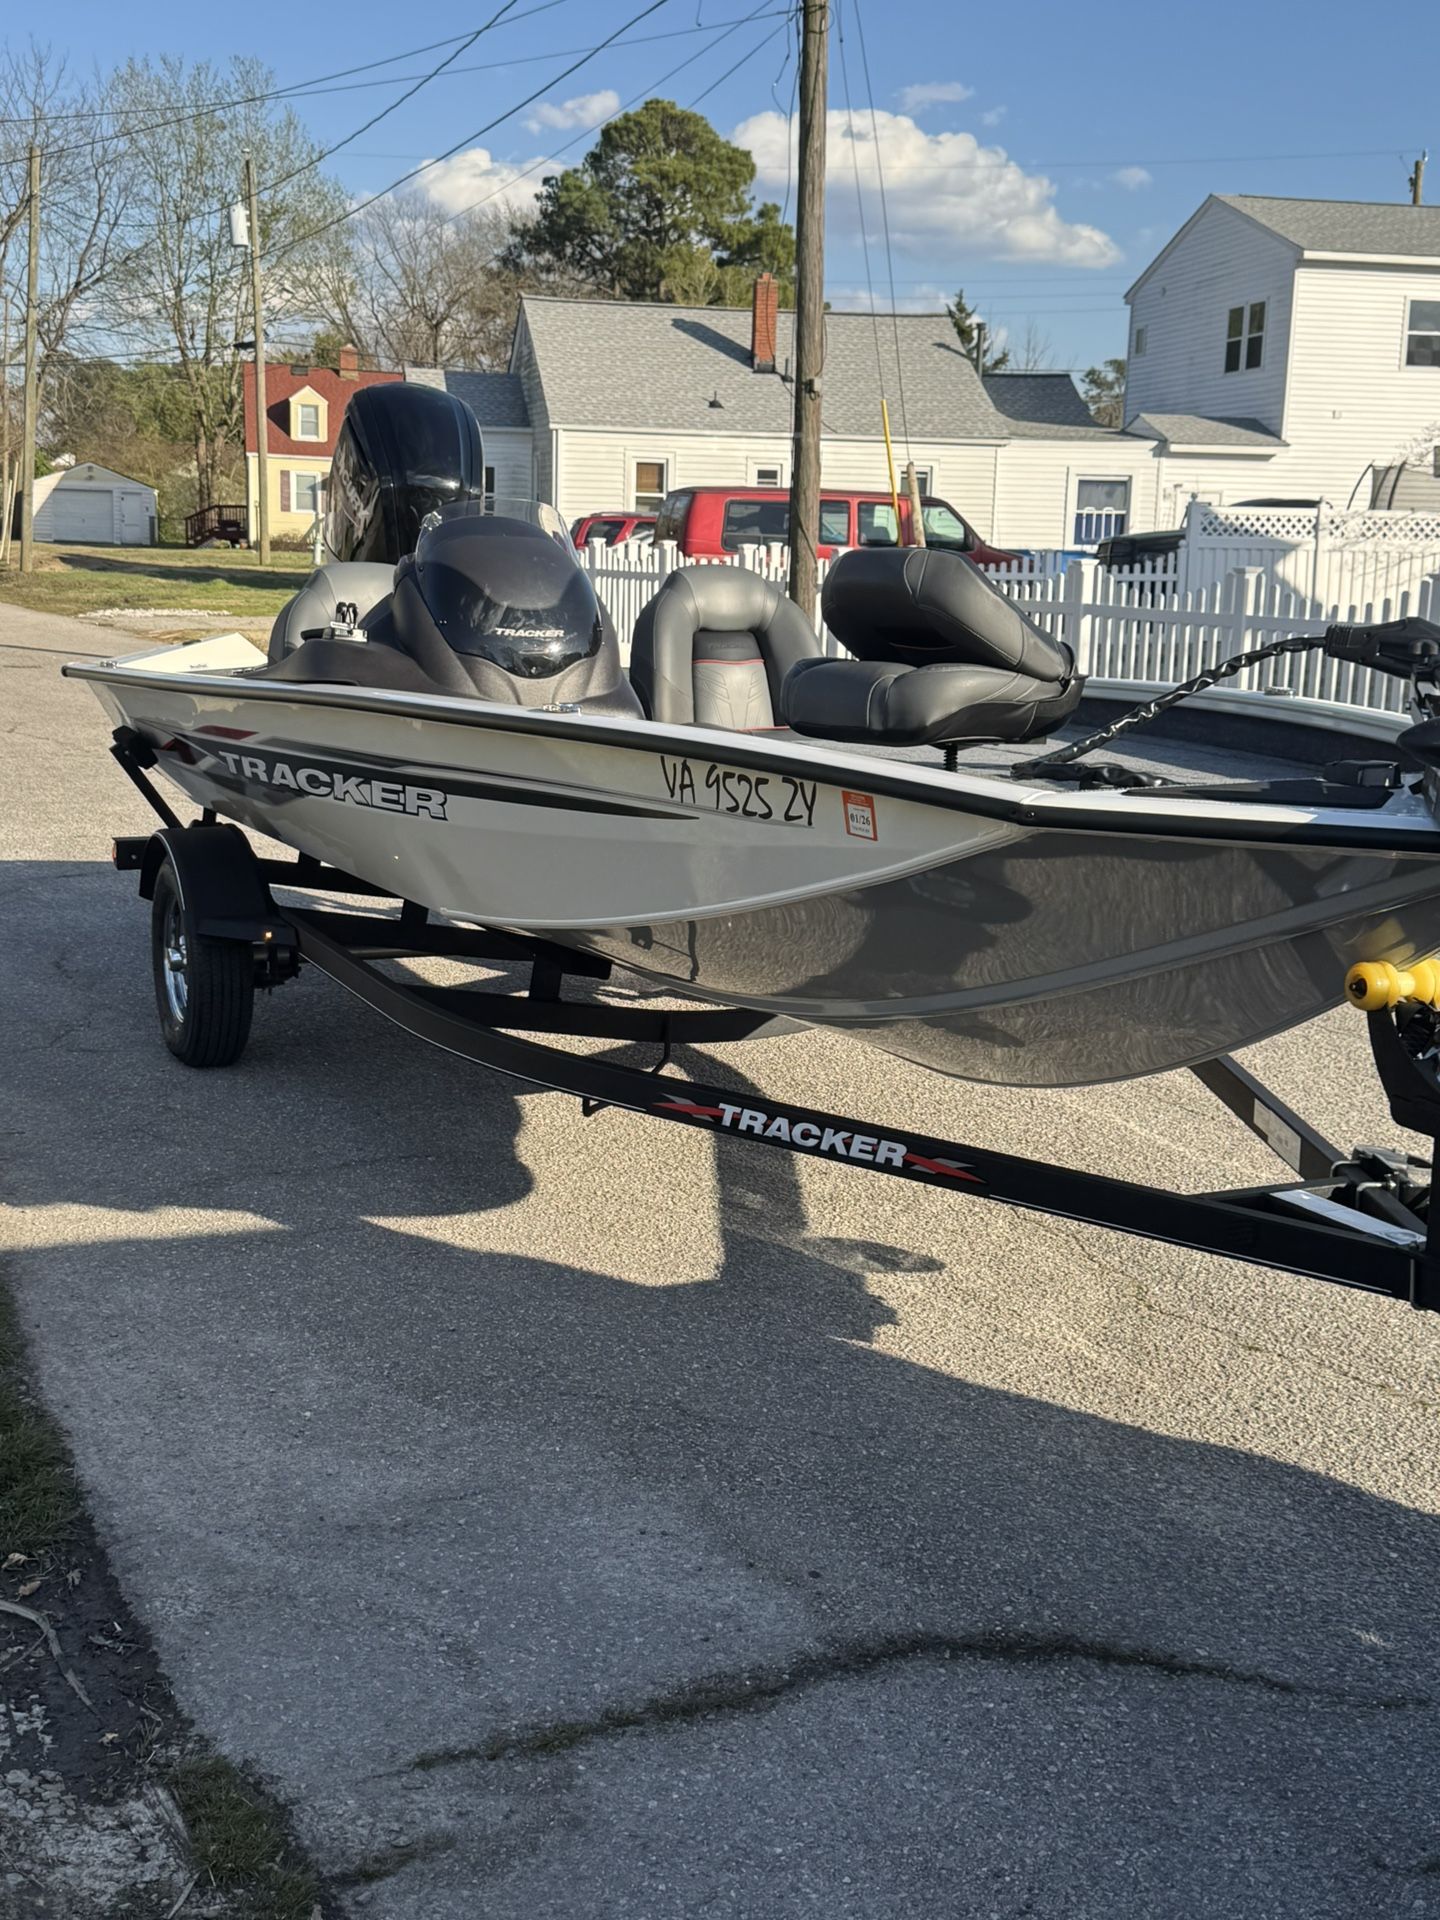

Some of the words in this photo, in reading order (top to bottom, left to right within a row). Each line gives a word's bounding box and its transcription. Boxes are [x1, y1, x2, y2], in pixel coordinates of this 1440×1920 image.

[495, 627, 565, 638] TRACKER
[218, 751, 448, 821] TRACKER
[660, 755, 696, 804] VA
[705, 764, 773, 820] 9525
[849, 812, 871, 826] 01/26
[718, 1103, 907, 1168] TRACKER
